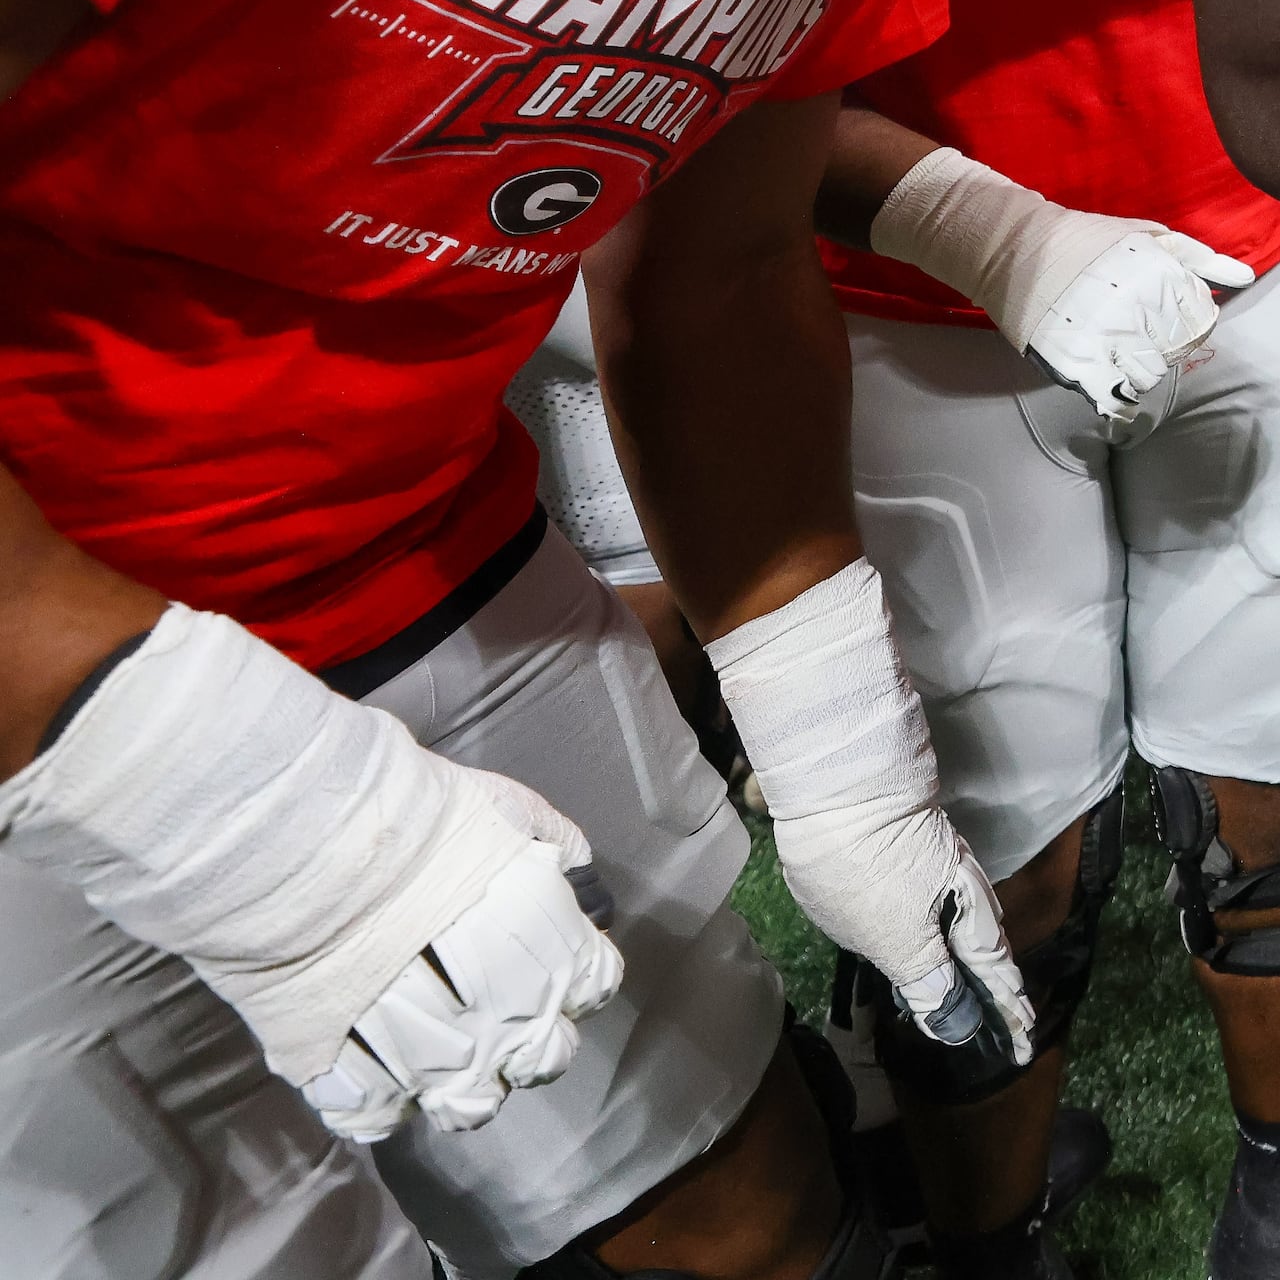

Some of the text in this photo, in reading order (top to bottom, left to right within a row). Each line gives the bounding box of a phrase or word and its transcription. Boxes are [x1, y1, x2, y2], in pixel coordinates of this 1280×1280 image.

[518, 63, 710, 144] GEORGIA
[323, 210, 579, 276] IT JUST MEANS MO
